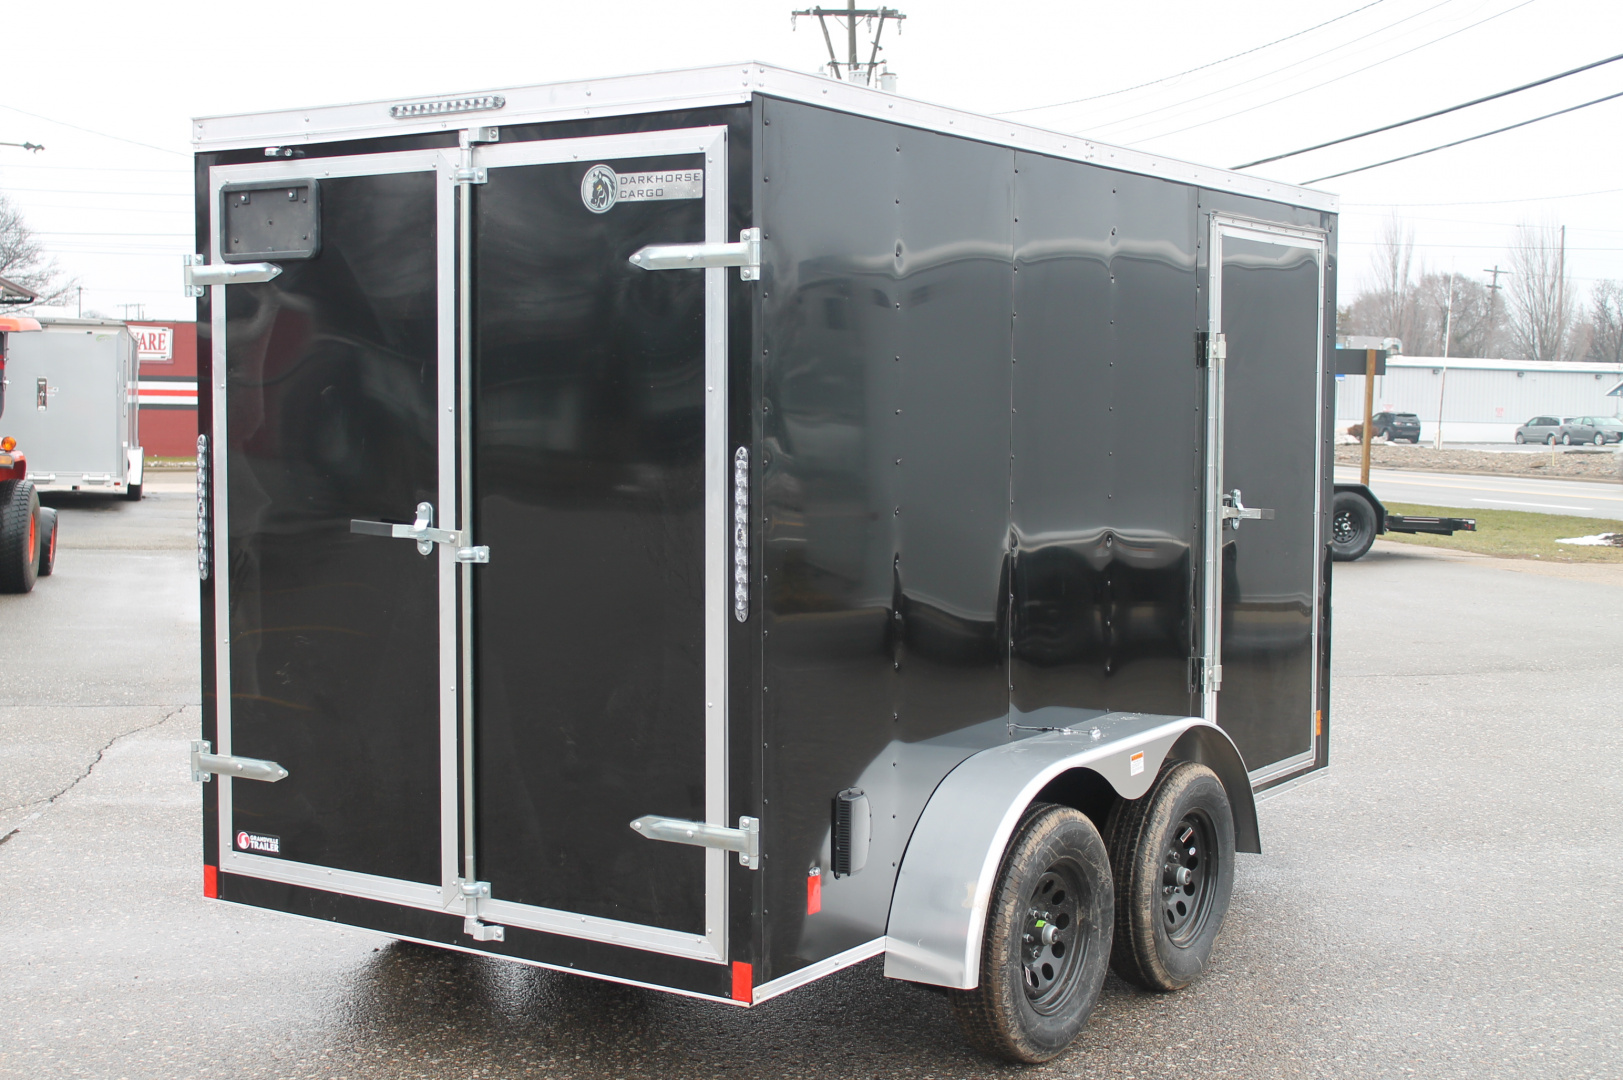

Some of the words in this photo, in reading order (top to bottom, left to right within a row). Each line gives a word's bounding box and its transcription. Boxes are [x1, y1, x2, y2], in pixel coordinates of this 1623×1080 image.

[620, 172, 701, 185] DARKHORSE
[620, 188, 664, 199] CARGO
[250, 841, 280, 852] TRAILER
